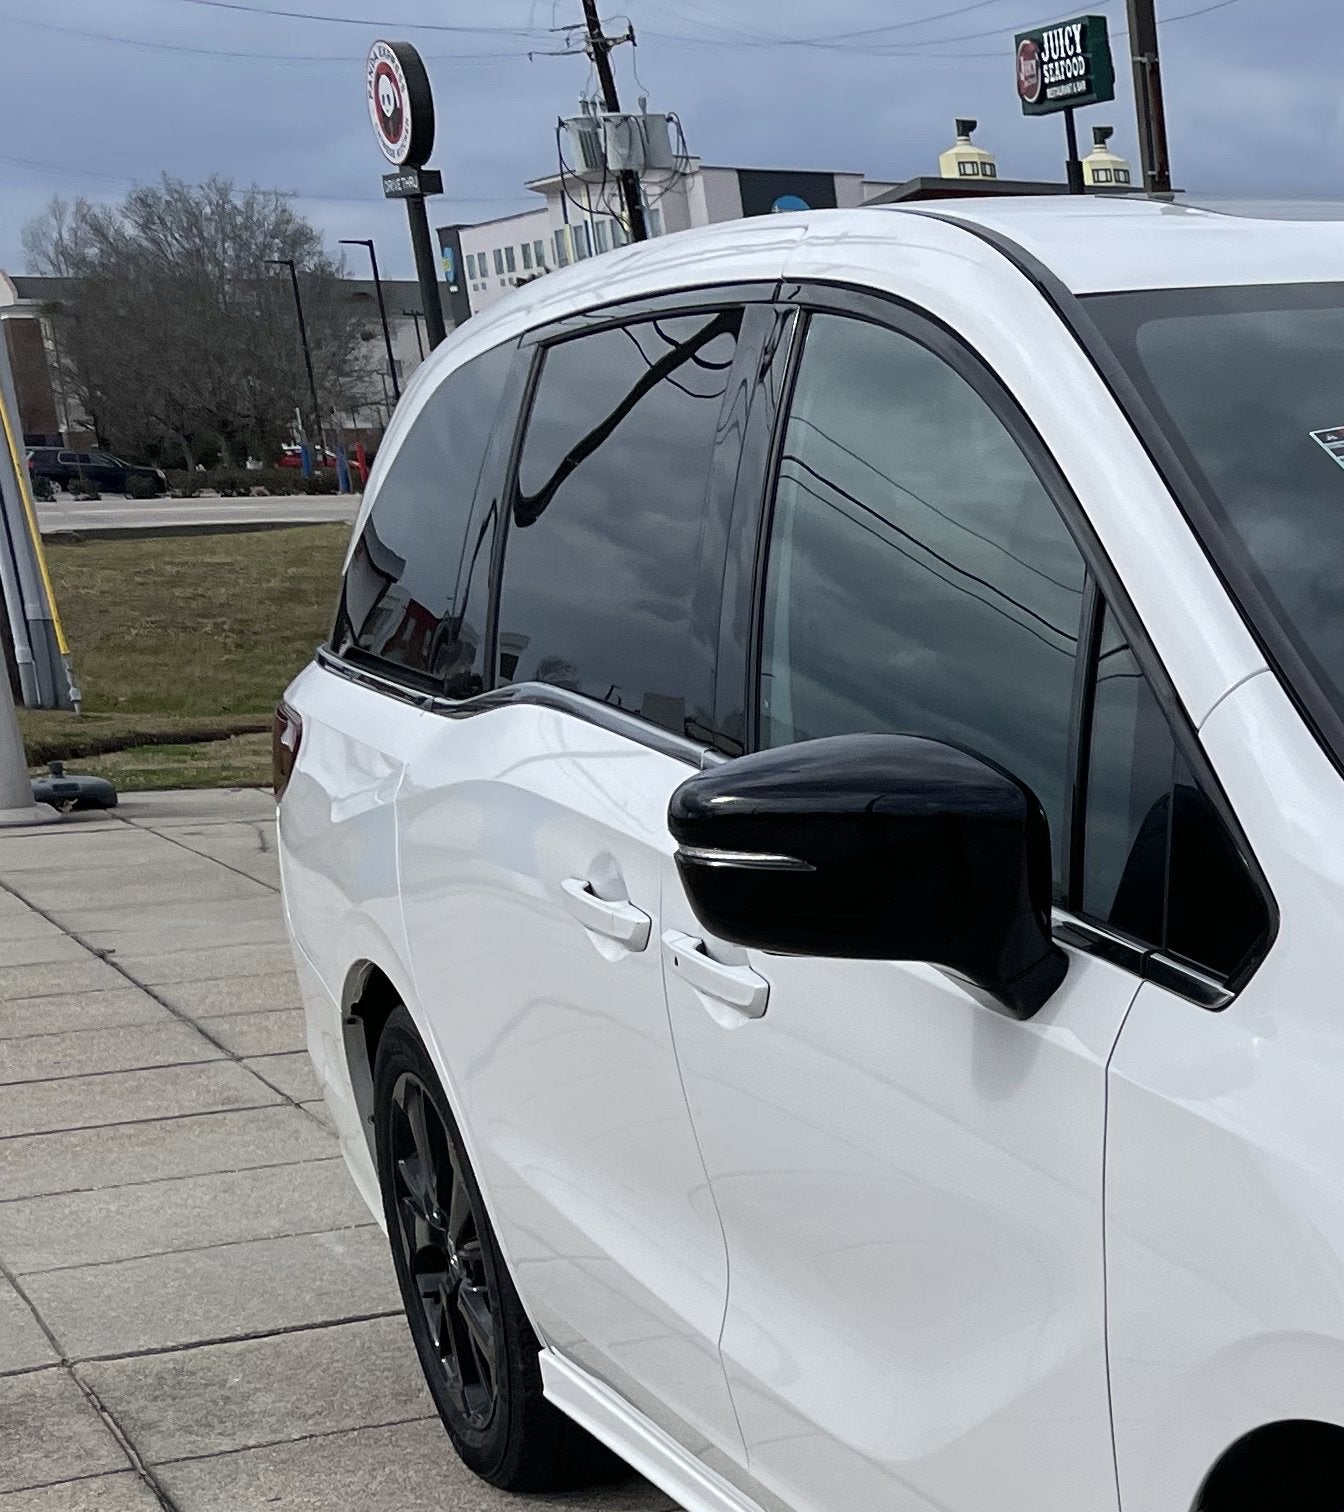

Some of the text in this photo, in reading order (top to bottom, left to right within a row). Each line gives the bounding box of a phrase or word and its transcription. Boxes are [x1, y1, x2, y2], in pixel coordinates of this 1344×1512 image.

[1041, 23, 1082, 62] JUICY
[367, 52, 379, 100] PANDA
[1043, 55, 1085, 84] SEAFOOD
